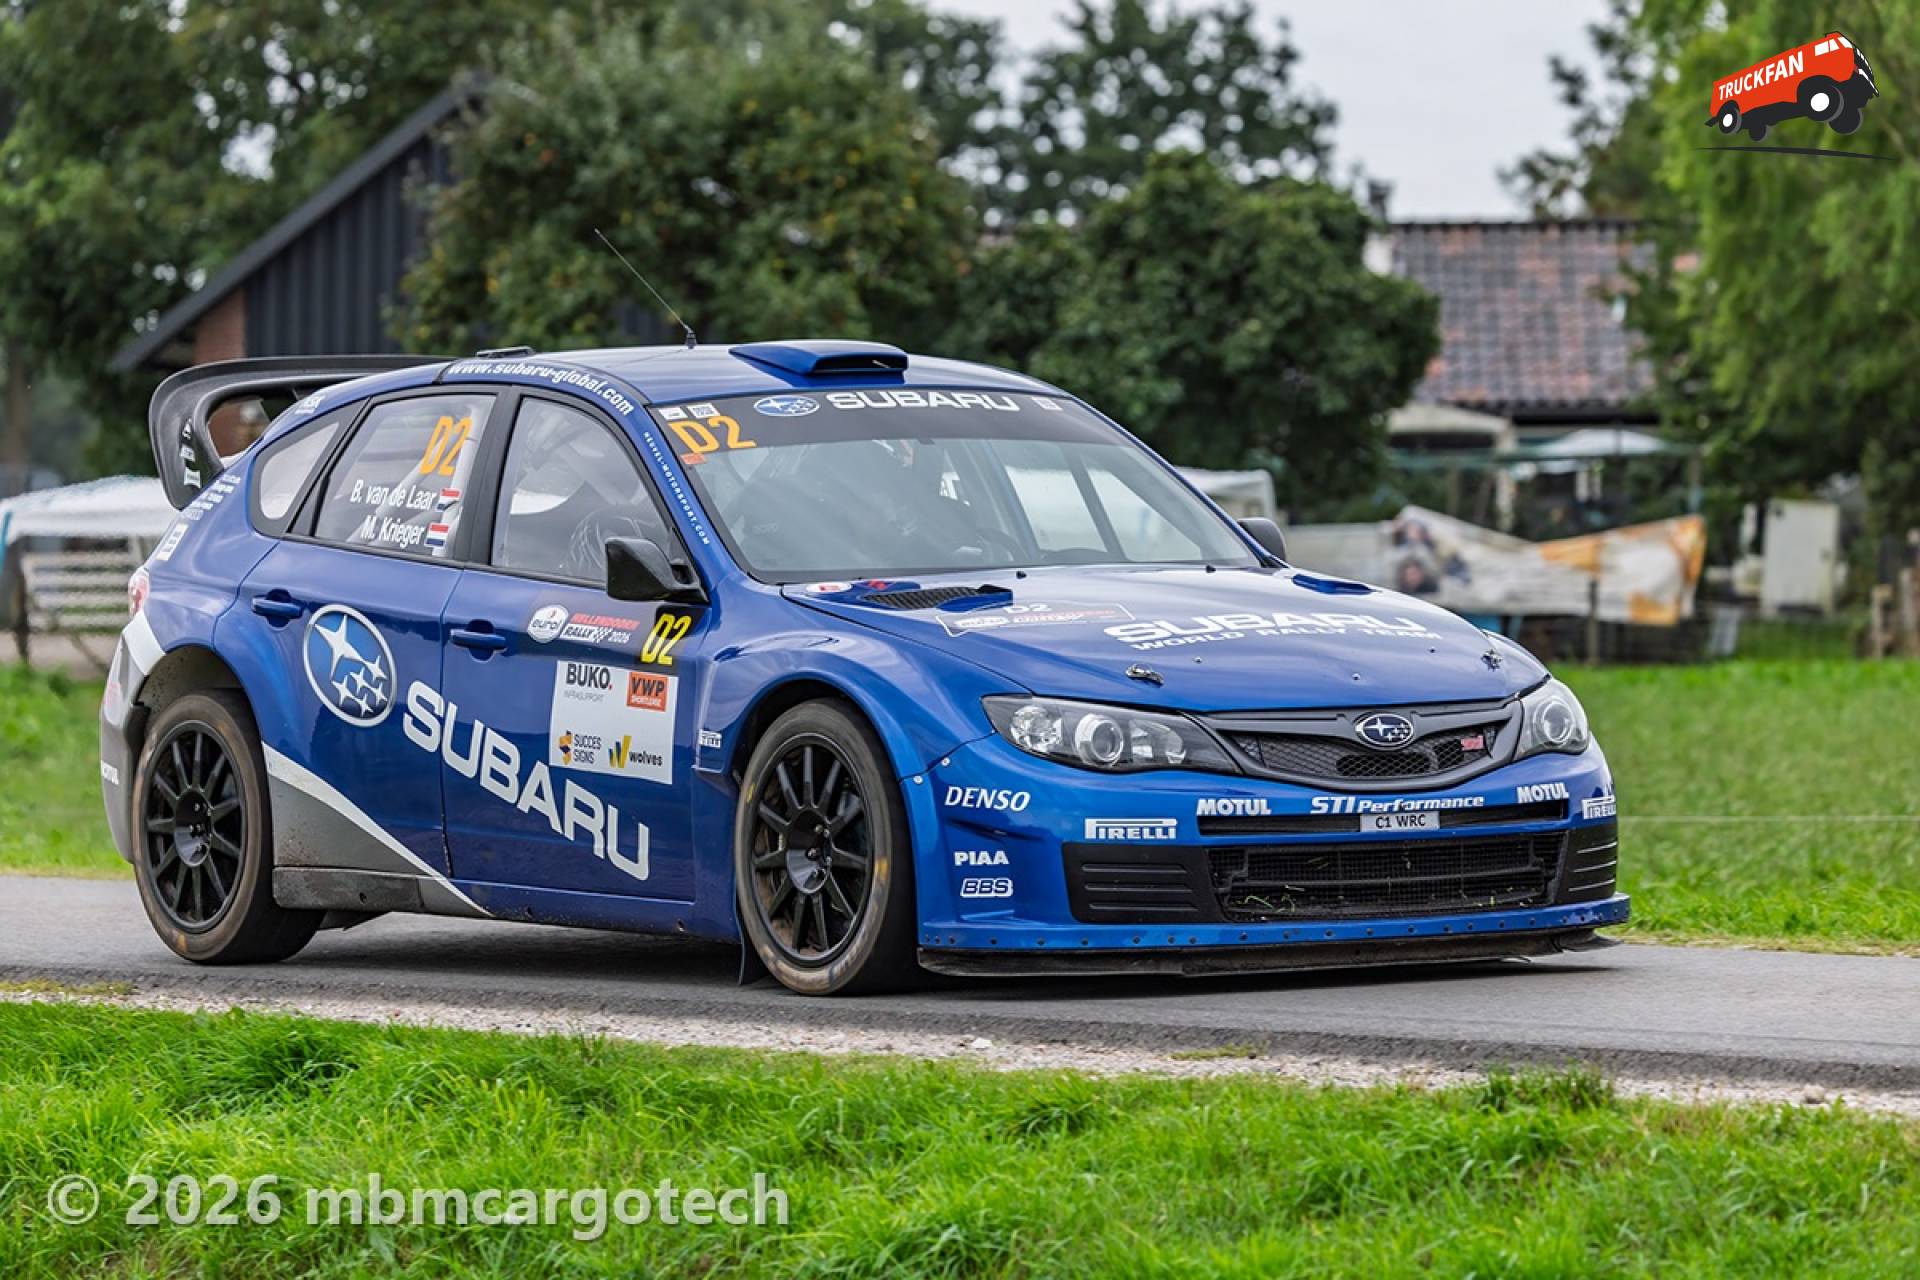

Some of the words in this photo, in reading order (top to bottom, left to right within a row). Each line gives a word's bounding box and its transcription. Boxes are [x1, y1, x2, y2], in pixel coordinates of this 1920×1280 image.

[449, 361, 635, 416] www.subaru-global.com
[826, 391, 1020, 411] SUBARU
[667, 416, 758, 454] D2
[350, 479, 364, 502] B.
[366, 485, 390, 505] van
[389, 484, 406, 507] de
[406, 485, 437, 511] Laar
[360, 514, 377, 539] M.
[379, 516, 426, 548] Krieger
[564, 626, 594, 638] RALLY
[1104, 612, 1428, 642] SUBARU
[1129, 630, 1246, 650] WORLD
[1255, 627, 1348, 637] RALLY
[1361, 627, 1443, 640] TEAM
[632, 677, 665, 697] VWP
[574, 734, 602, 750] SUCCES
[573, 750, 595, 765] SIGNS
[629, 751, 664, 767] wolves
[403, 680, 649, 881] SUBARU
[944, 786, 1031, 811] DENSO
[1517, 783, 1569, 803] MOTUL
[1196, 799, 1272, 816] MOTUL
[1310, 796, 1356, 814] STI
[1357, 796, 1485, 813] Performance
[1085, 818, 1178, 839] PIRELLI
[1375, 816, 1392, 829] C1
[1396, 815, 1427, 828] WRC
[954, 851, 1010, 866] PIAA
[961, 879, 1013, 897] BBS
